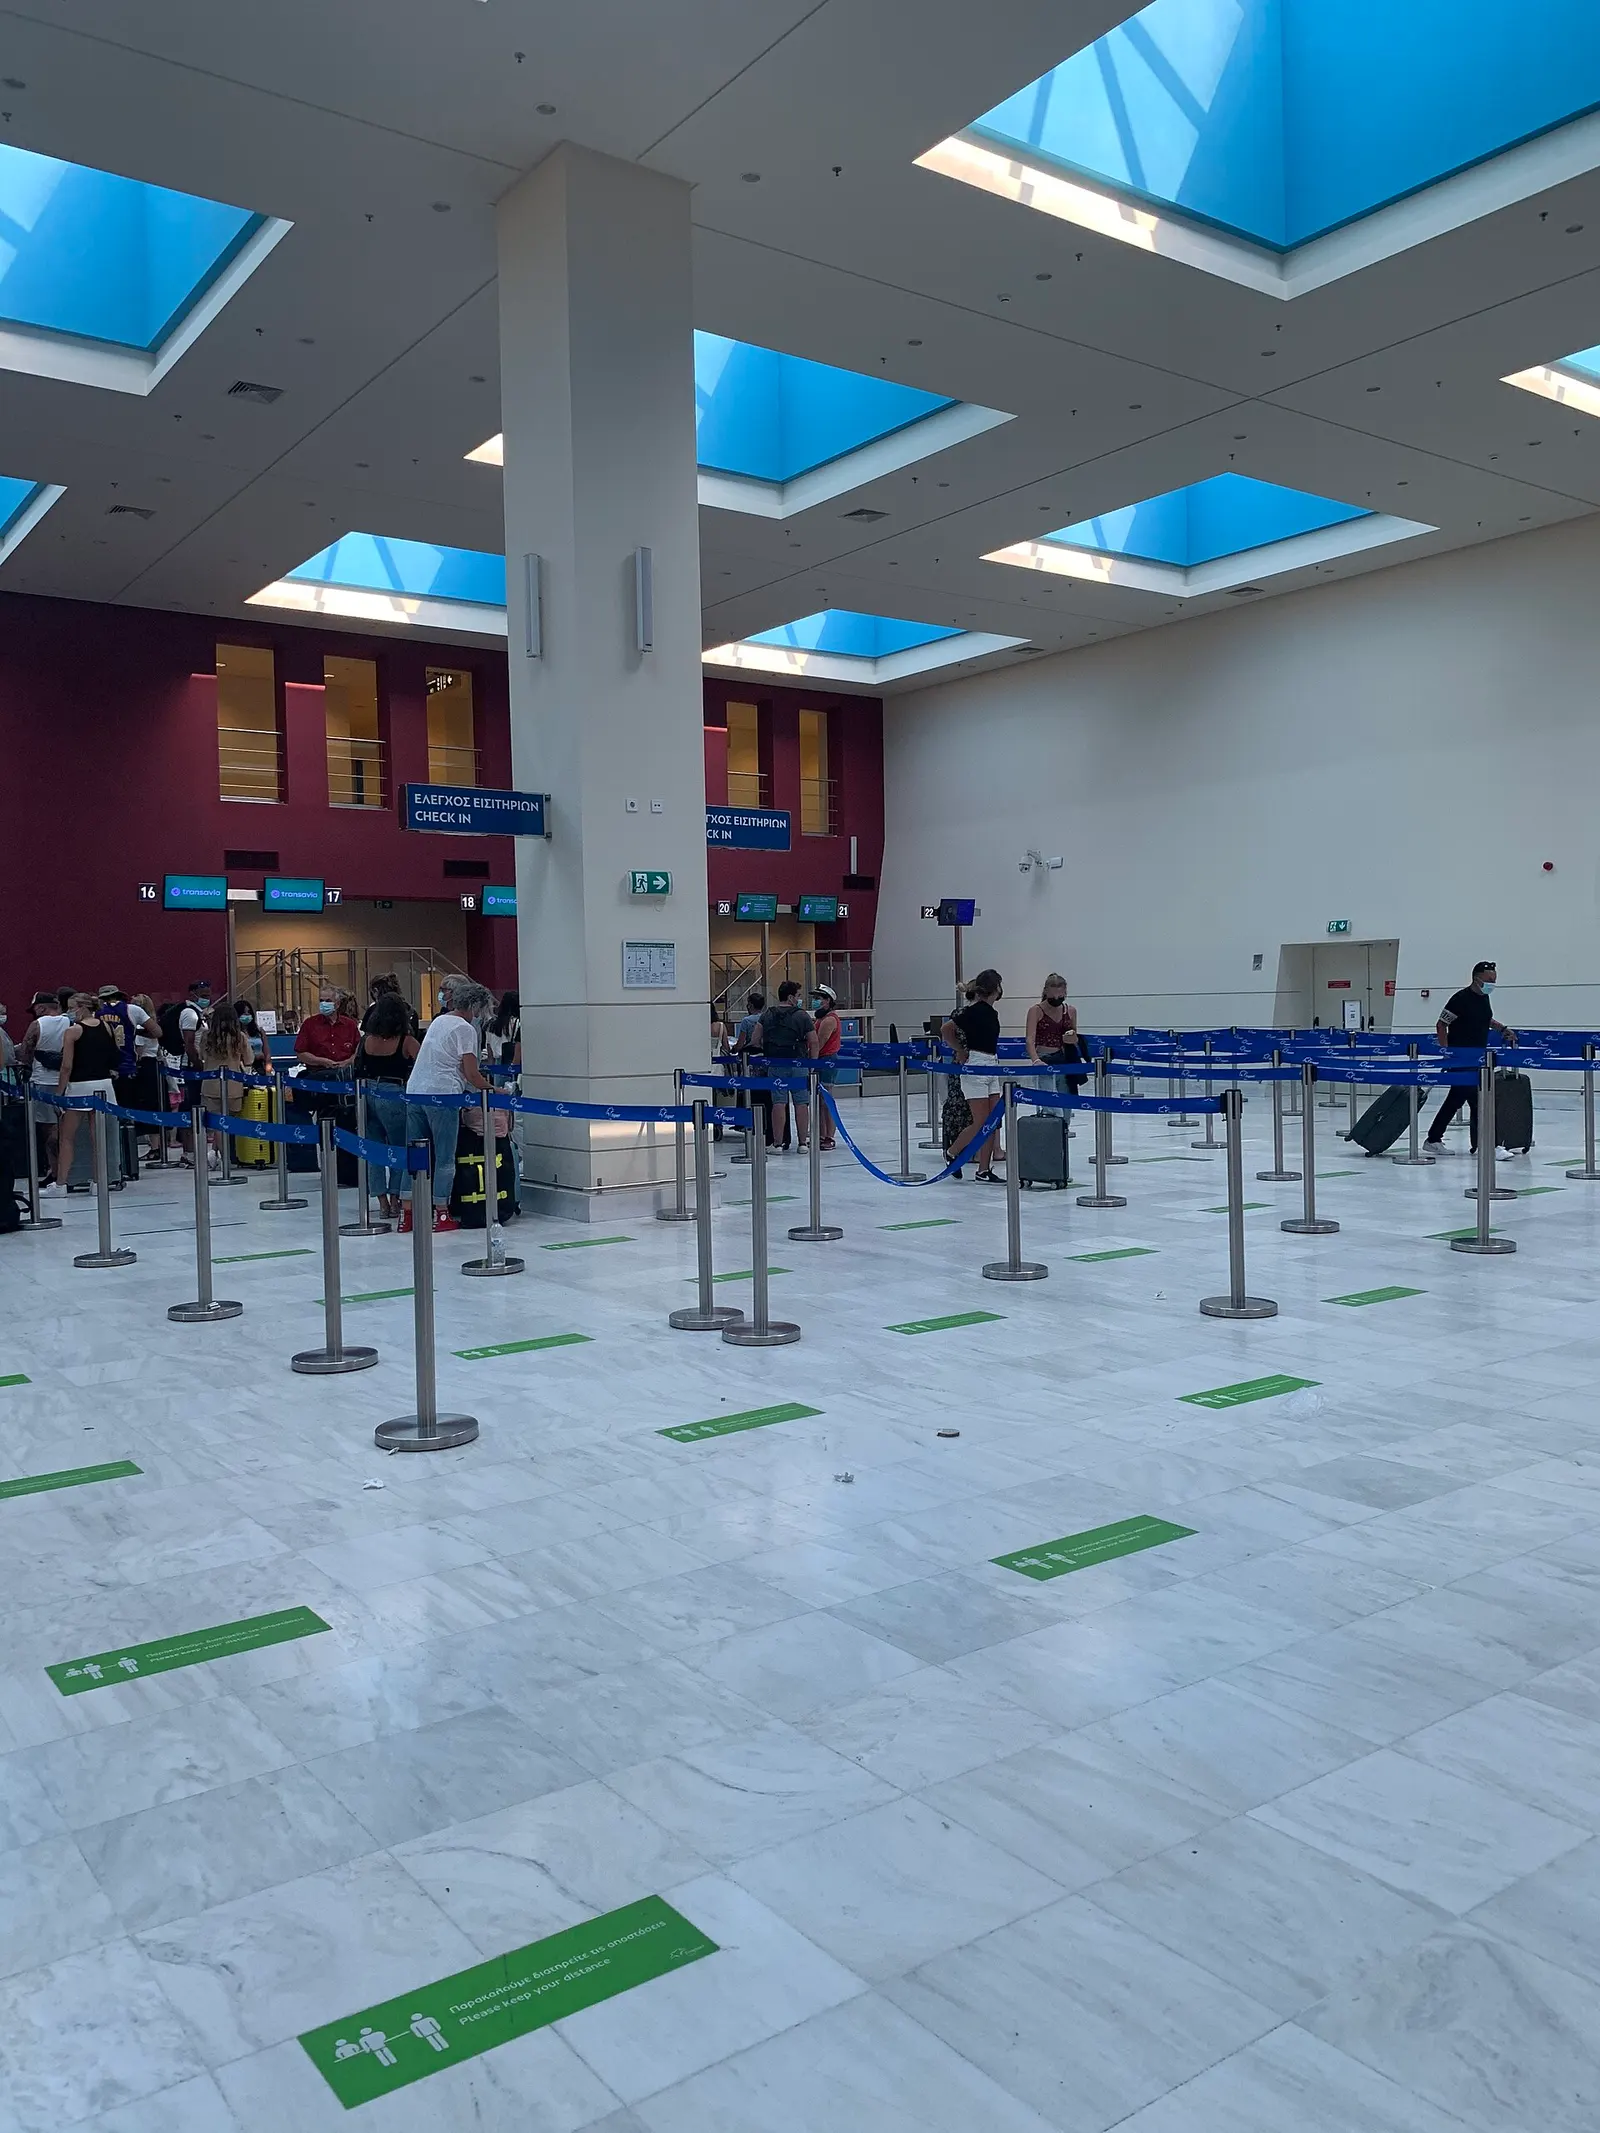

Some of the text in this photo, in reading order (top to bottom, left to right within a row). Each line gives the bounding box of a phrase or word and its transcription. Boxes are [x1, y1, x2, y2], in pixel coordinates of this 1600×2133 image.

[414, 793, 539, 812] ΕΛΕΓΧΟΣ ΕΙΣΙΤΗΡΙΩΝ
[415, 810, 472, 824] CHECK IN
[734, 816, 787, 829] ΕΙΣΙΤΗΡΙΩΝ
[721, 830, 732, 840] IN
[140, 886, 156, 899] 16
[182, 888, 221, 897] transavia
[281, 891, 318, 899] transavia
[327, 891, 340, 903] 17
[462, 896, 475, 908] 18
[719, 903, 730, 914] 20
[839, 906, 848, 916] 21
[925, 907, 934, 918] 22
[449, 1920, 667, 2014] Παρακαλούμε διατηρείτε τις αποστάσεις
[459, 1957, 612, 2026] Please keep your distance
